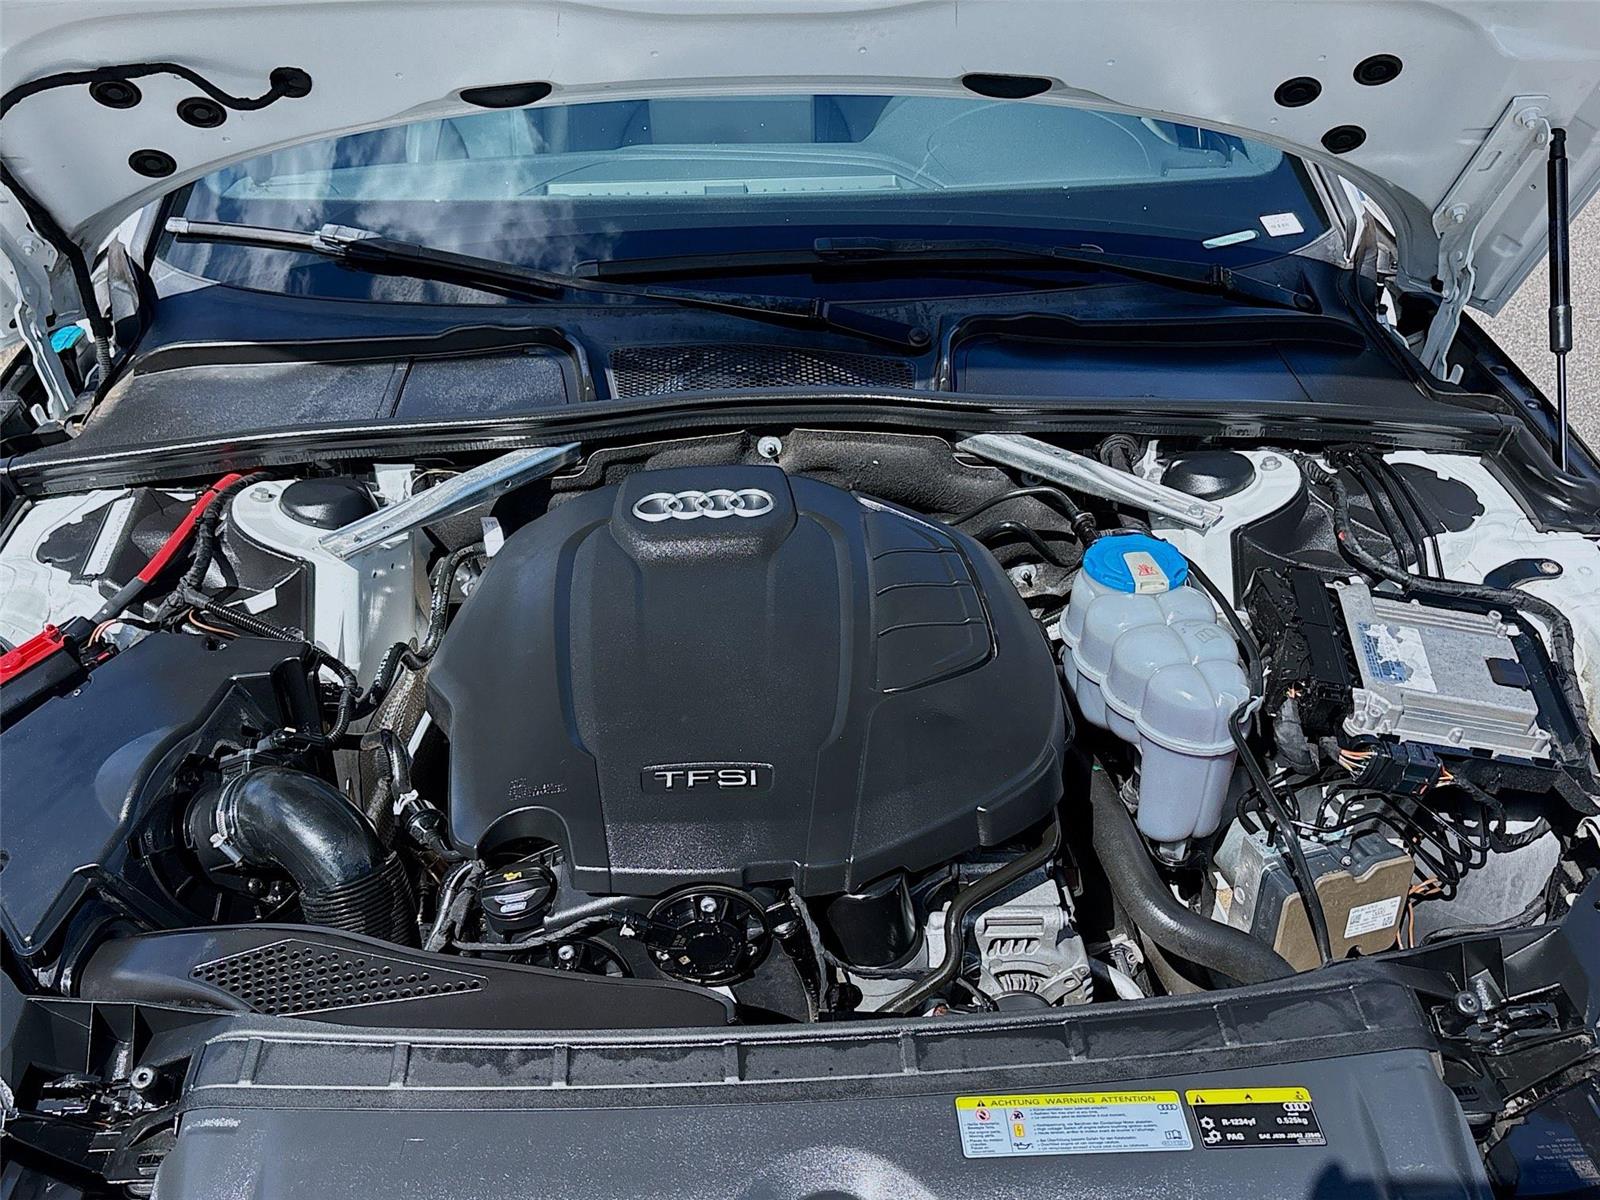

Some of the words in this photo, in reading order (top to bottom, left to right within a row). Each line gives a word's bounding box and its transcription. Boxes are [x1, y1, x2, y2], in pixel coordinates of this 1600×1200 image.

[654, 769, 757, 788] TFSI
[991, 1098, 1040, 1107] ACHTUNG
[1044, 1096, 1096, 1105] WARNING
[1100, 1095, 1156, 1104] ATTENTION
[1226, 1133, 1245, 1141] PAG
